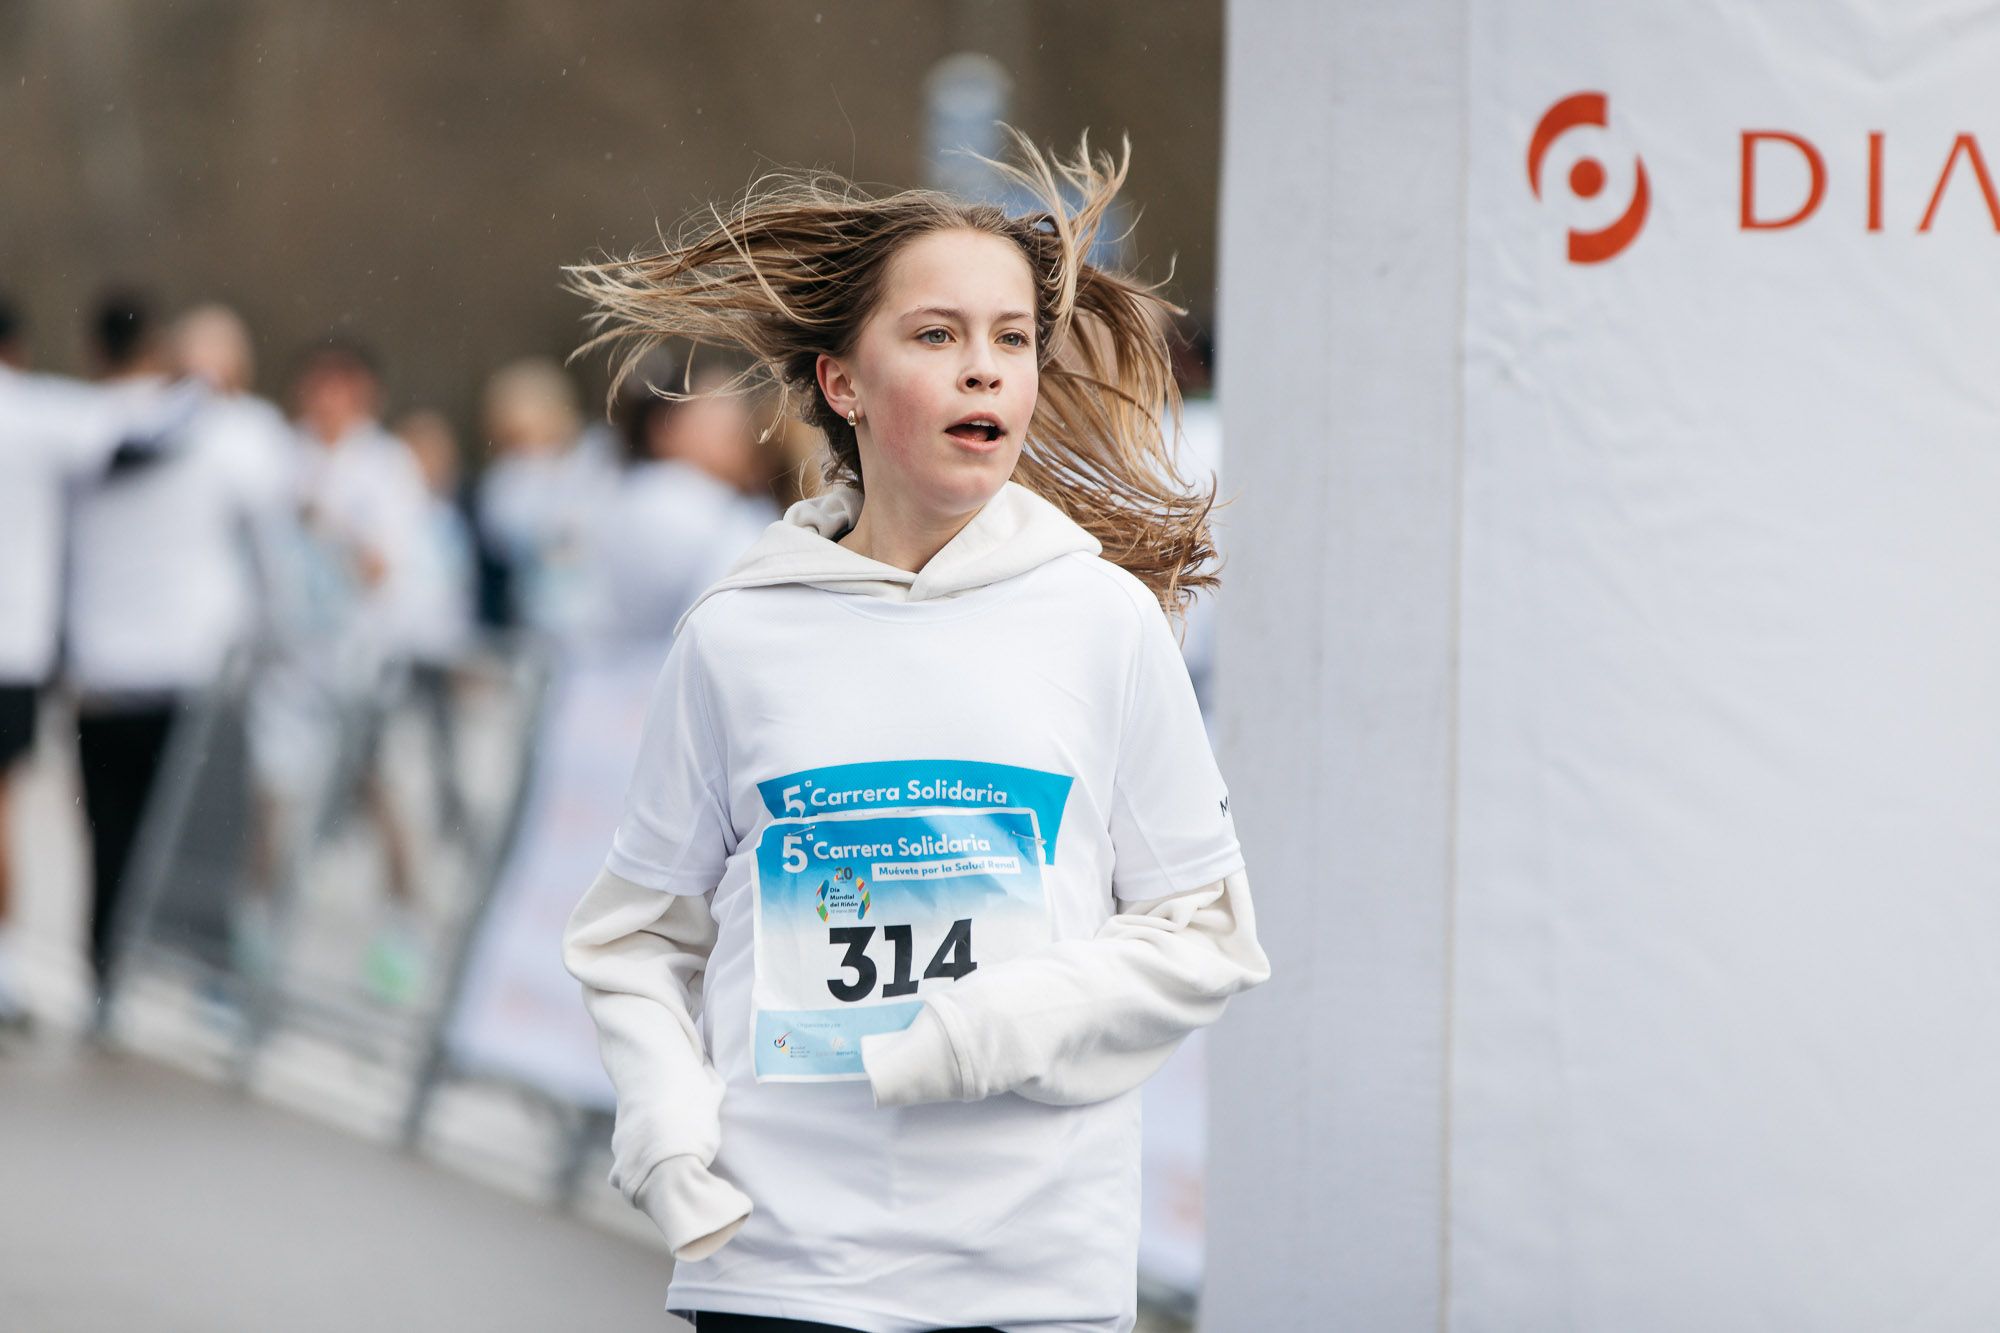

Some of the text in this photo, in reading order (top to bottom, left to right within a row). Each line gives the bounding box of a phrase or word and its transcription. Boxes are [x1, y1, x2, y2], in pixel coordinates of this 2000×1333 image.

[810, 787, 900, 807] Carrera
[907, 779, 1008, 805] Solidaria
[813, 841, 894, 859] Carrera
[898, 833, 991, 857] Solidaria
[879, 866, 919, 876] Muévete
[922, 867, 938, 877] por
[942, 864, 952, 873] la
[955, 860, 986, 871] Salud
[827, 918, 978, 1003] 314
